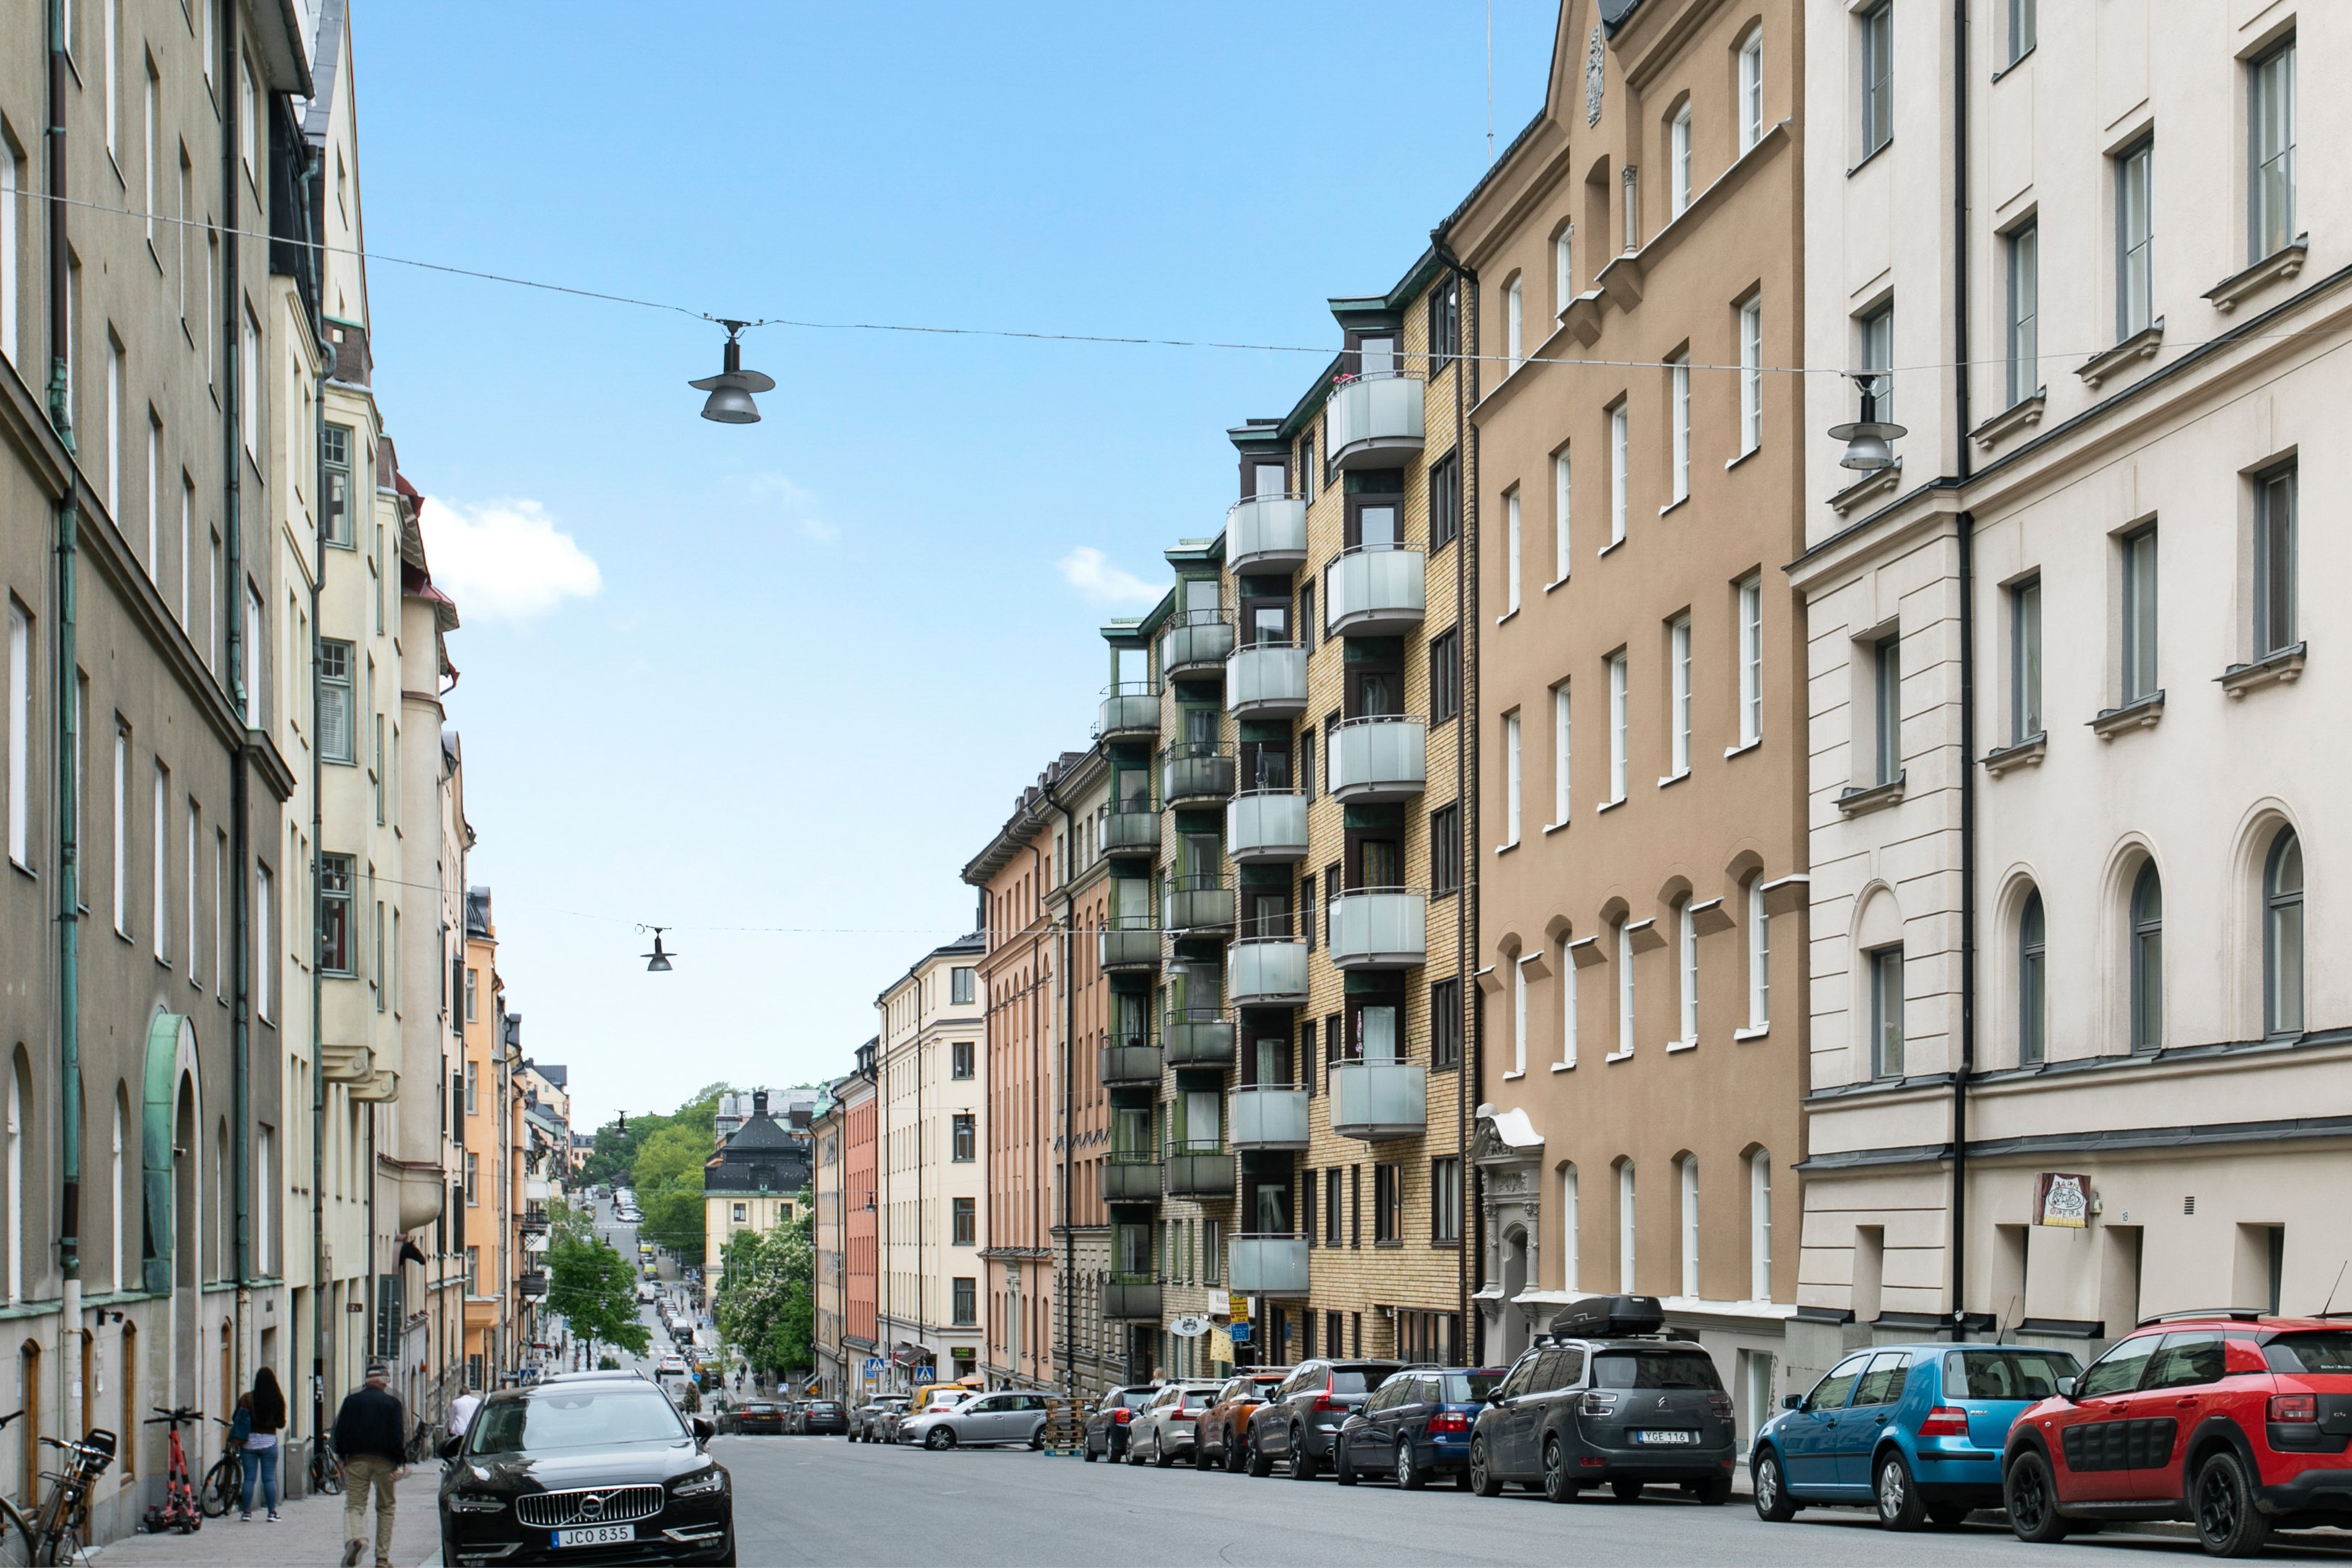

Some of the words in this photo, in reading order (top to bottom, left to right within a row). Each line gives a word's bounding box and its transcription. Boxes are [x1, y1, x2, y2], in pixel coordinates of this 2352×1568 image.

[2055, 1181, 2079, 1190] BARN
[2049, 1208, 2081, 1218] OPERA
[2122, 1212, 2128, 1222] 18
[1646, 1432, 1664, 1441] YGE
[1668, 1432, 1686, 1441] 116
[565, 1530, 595, 1545] JCO
[599, 1527, 629, 1542] 835
